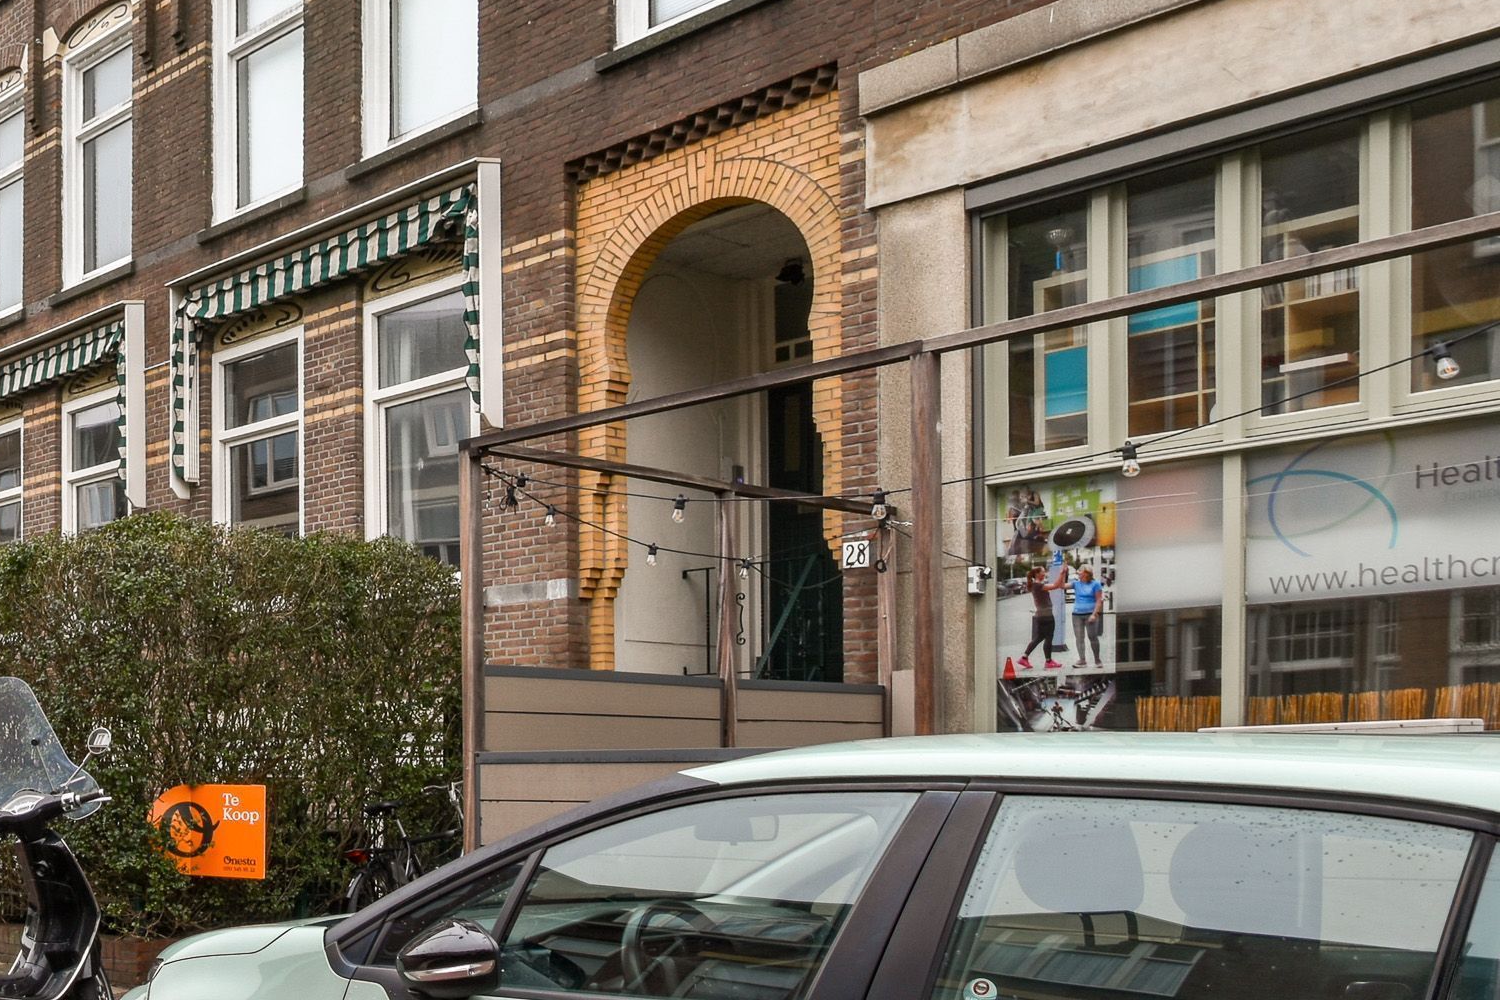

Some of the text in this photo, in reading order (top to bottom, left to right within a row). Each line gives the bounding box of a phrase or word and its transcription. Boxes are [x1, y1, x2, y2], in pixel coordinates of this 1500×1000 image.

[846, 543, 866, 566] 28
[222, 793, 240, 807] Te
[222, 807, 260, 825] Koop
[223, 855, 256, 866] Onesta
